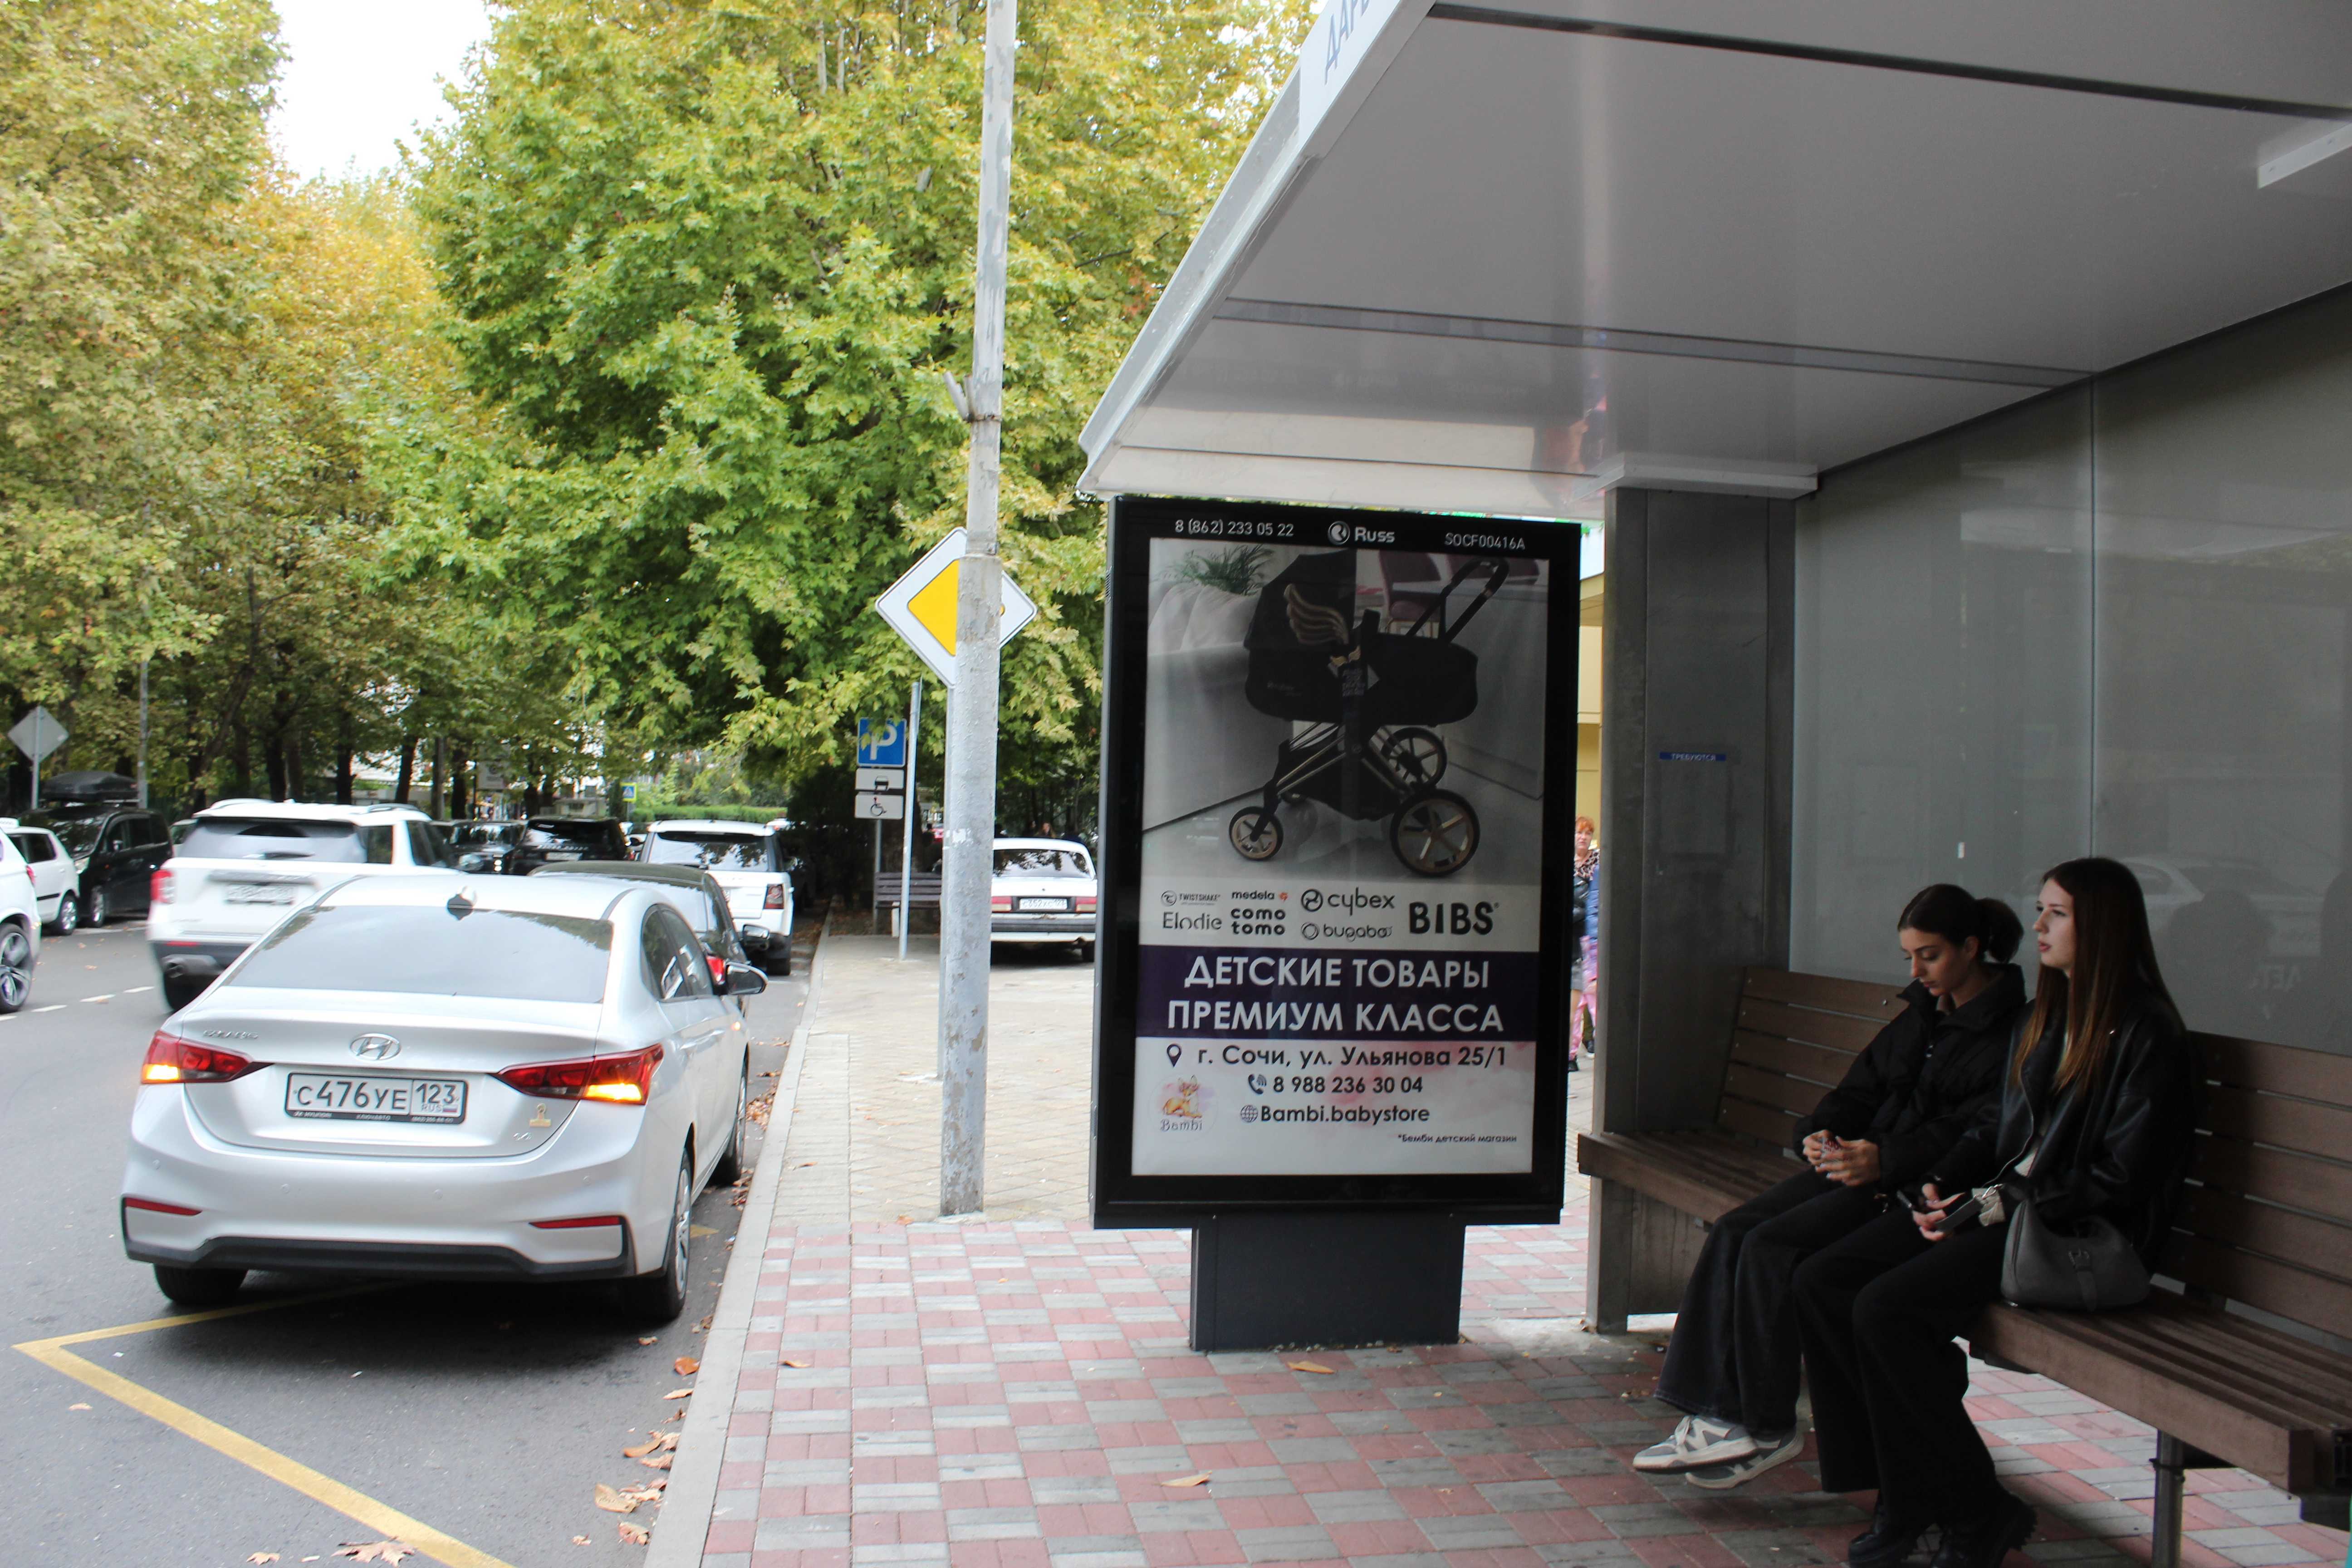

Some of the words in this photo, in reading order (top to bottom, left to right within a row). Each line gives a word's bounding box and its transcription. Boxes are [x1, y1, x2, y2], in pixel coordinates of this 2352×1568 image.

[1325, 0, 1369, 85] ДАР
[1175, 519, 1184, 533] 8
[1188, 519, 1223, 534] (862)
[1227, 522, 1252, 535] 233
[1256, 523, 1273, 536] 05
[1277, 524, 1294, 537] 22
[1354, 526, 1395, 543] Russ
[870, 723, 897, 760] P
[1231, 890, 1275, 900] medela
[1328, 887, 1395, 916] cybex
[1163, 911, 1222, 930] Elodie
[1231, 908, 1285, 920] como
[1409, 901, 1494, 936] BIBS
[1231, 921, 1285, 935] tomo
[1184, 956, 1342, 989] ДЕТСКИЕ
[1352, 959, 1489, 989] ТОВАРЫ
[1167, 1000, 1343, 1032] ПРЕМИУМ
[1356, 1003, 1504, 1032] КЛАССА
[1198, 1049, 1213, 1063] г.
[1222, 1044, 1291, 1067] Сочи,
[1300, 1050, 1332, 1070] ул.
[1340, 1046, 1450, 1066] Ульянова
[1457, 1046, 1506, 1068] 25/1
[297, 1080, 408, 1110] С476УЕ
[415, 1083, 456, 1104] 123
[1273, 1076, 1284, 1093] 8
[1292, 1076, 1326, 1093] 988
[1331, 1077, 1366, 1094] 236
[1372, 1077, 1395, 1094] 30
[1401, 1077, 1423, 1093] 04
[421, 1103, 442, 1112] RUS
[1261, 1105, 1430, 1126] Bambi.babystore
[1435, 1134, 1475, 1143] детский
